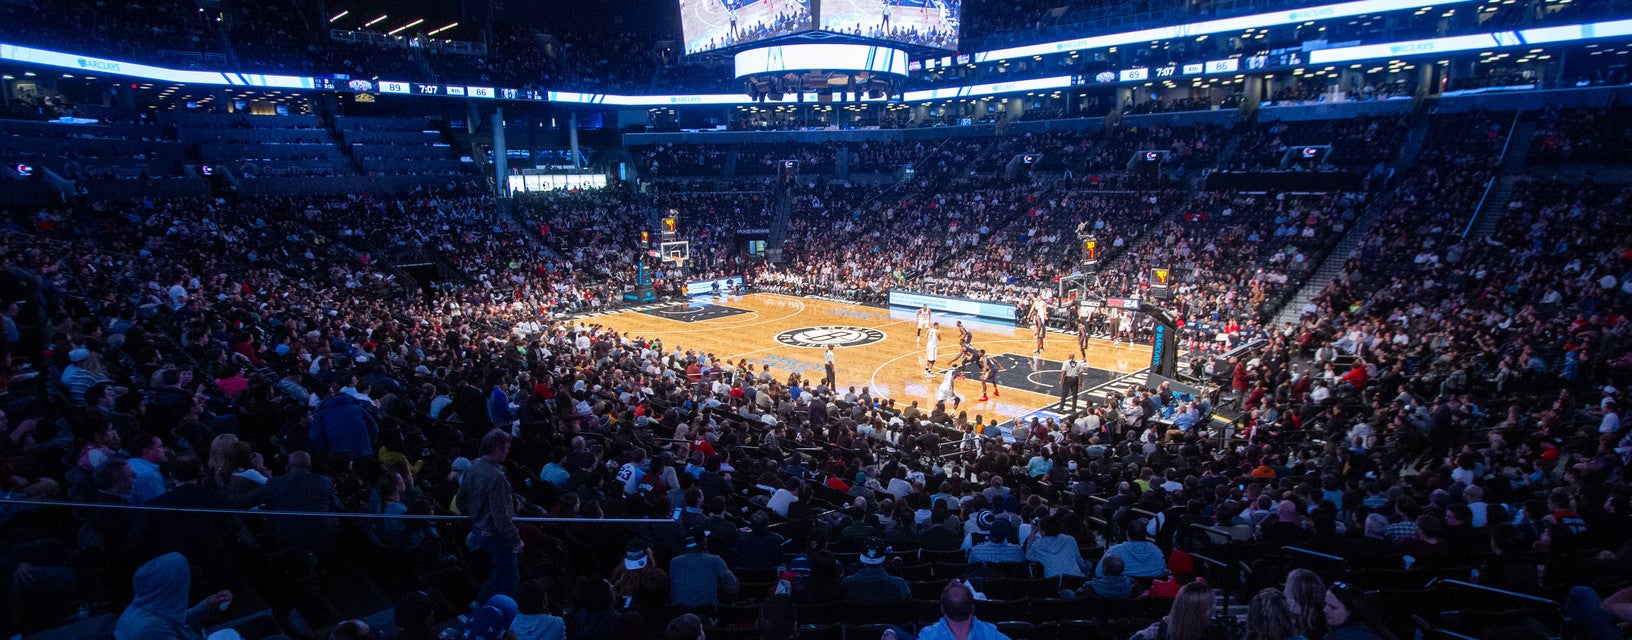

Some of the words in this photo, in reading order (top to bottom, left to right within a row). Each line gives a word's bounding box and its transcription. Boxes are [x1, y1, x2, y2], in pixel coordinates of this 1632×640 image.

[1129, 71, 1140, 79] 89
[1156, 67, 1175, 78] 7:07
[1215, 61, 1227, 71] 86
[389, 84, 401, 92] 89
[419, 85, 438, 94] 7:07
[1152, 333, 1163, 366] BARCLAYS
[616, 466, 633, 481] 23
[622, 595, 633, 609] 7
